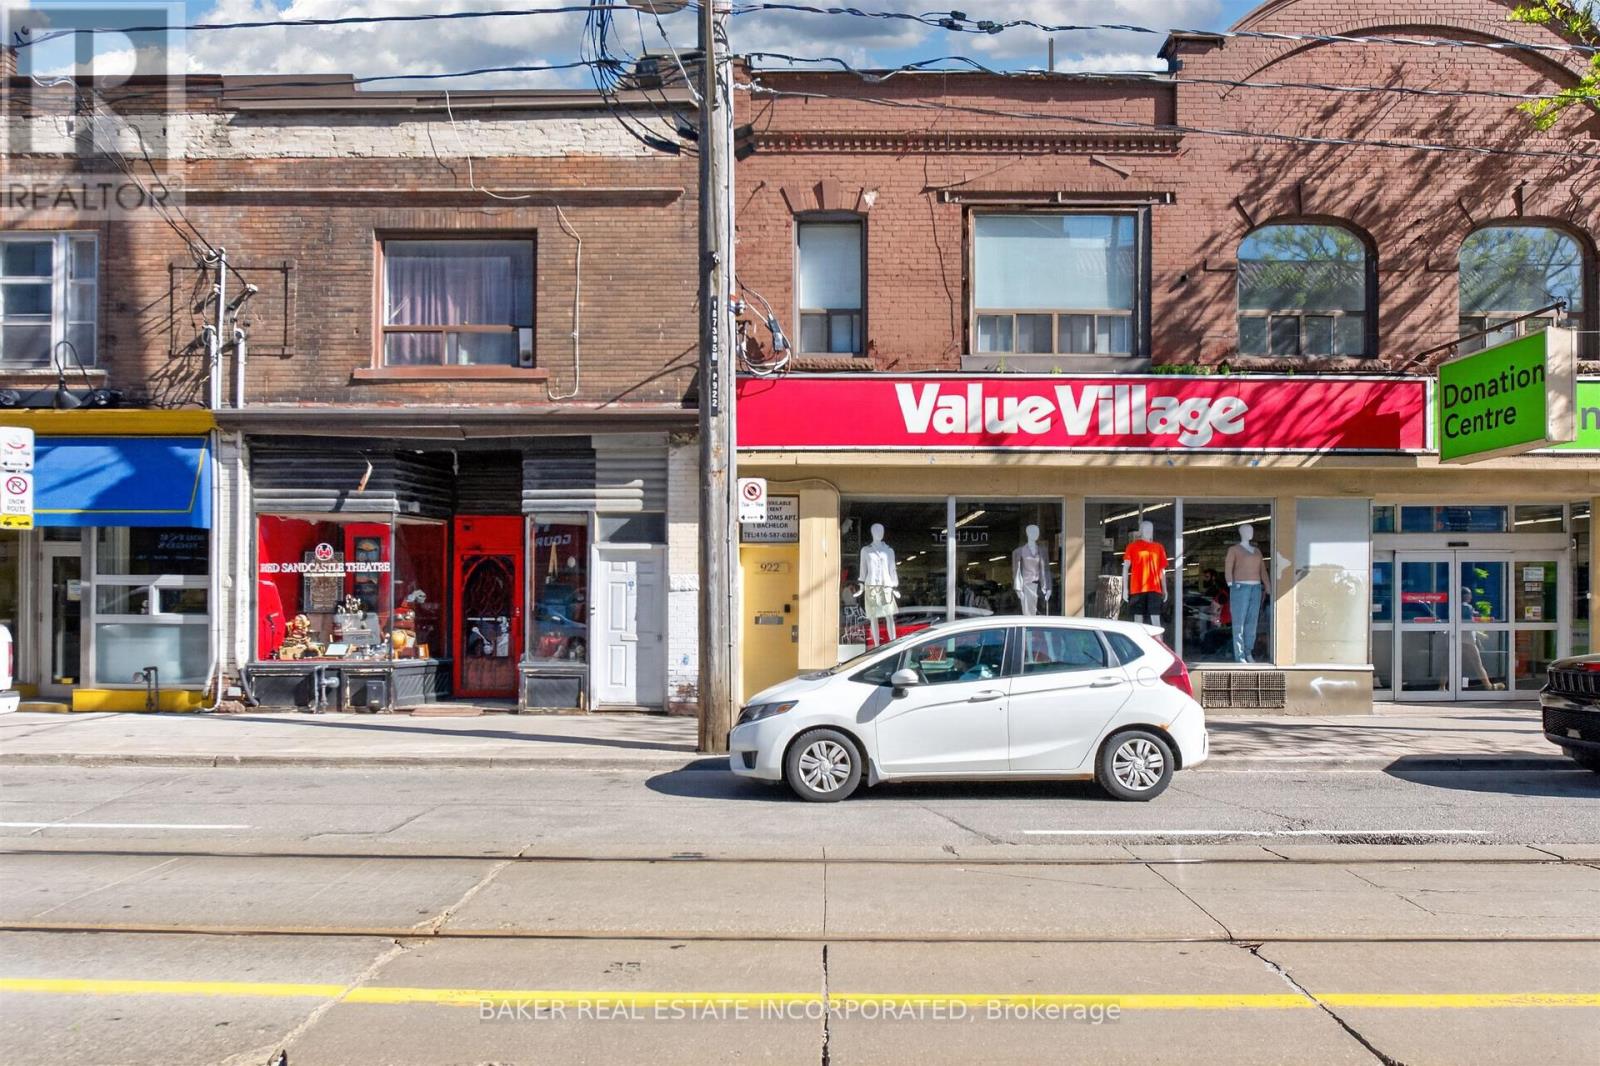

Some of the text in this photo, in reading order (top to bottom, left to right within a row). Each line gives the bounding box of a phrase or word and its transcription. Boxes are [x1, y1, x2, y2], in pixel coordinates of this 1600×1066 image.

[1443, 365, 1545, 409] Donation
[895, 383, 1249, 447] Value Village
[1444, 406, 1517, 438] Centre
[260, 562, 391, 573] RED SANDCASTLE THEATRE
[760, 562, 780, 572] 922
